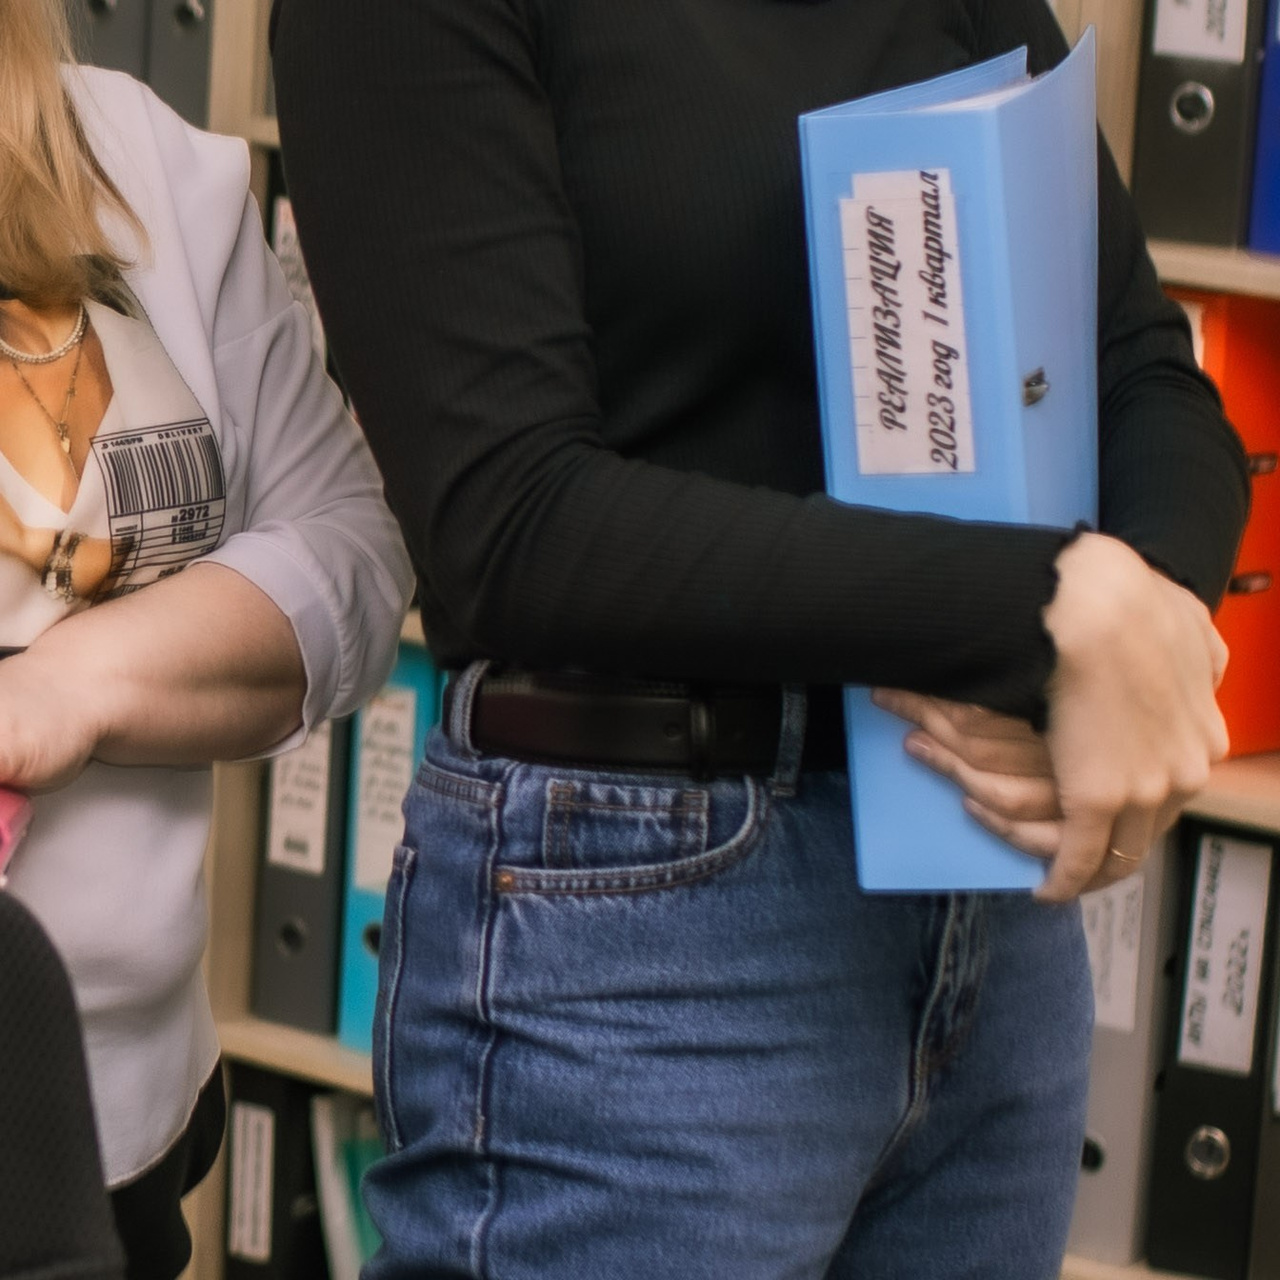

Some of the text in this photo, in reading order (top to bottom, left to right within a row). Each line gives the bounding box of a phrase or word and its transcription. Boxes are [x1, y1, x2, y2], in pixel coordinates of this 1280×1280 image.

[865, 205, 908, 433] РЕАЛИЗАЦИЯ
[918, 170, 960, 471] 2023 год 1 квартал
[157, 427, 204, 440] DELIVERY
